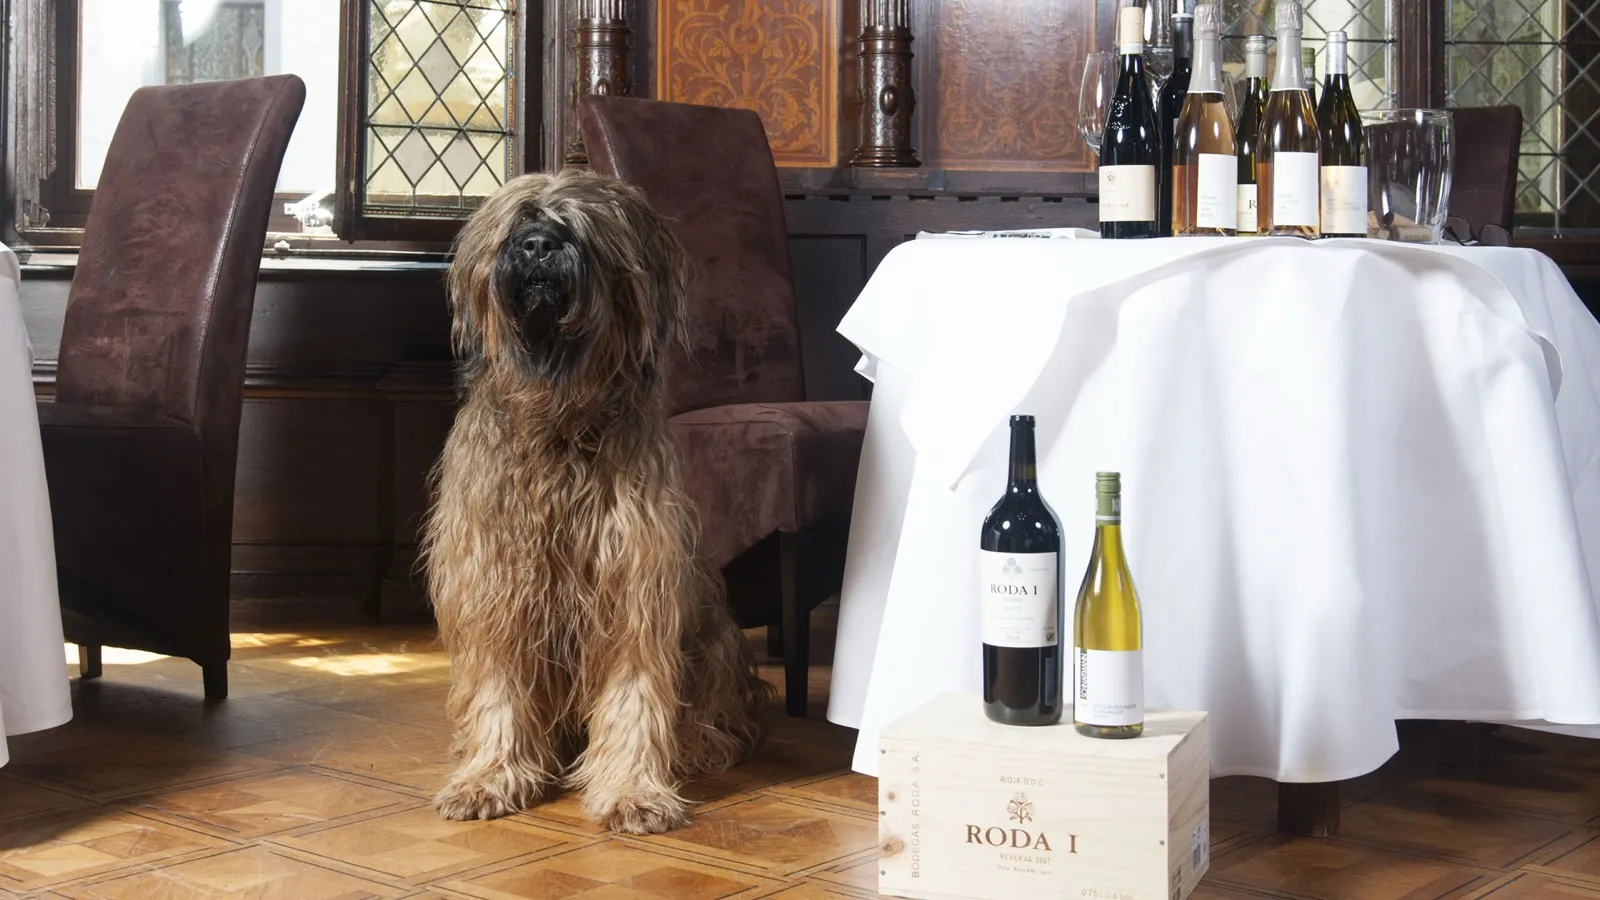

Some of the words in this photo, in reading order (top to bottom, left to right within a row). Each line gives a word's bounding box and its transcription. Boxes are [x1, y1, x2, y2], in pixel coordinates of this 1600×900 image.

[990, 583, 1028, 595] RODA
[1033, 585, 1038, 595] I
[1000, 775, 1021, 784] RIOJA
[911, 781, 920, 817] RODA
[965, 824, 1052, 851] RODA
[1068, 834, 1078, 854] I
[911, 823, 920, 878] BODEGAS
[1000, 852, 1033, 862] RESERVA
